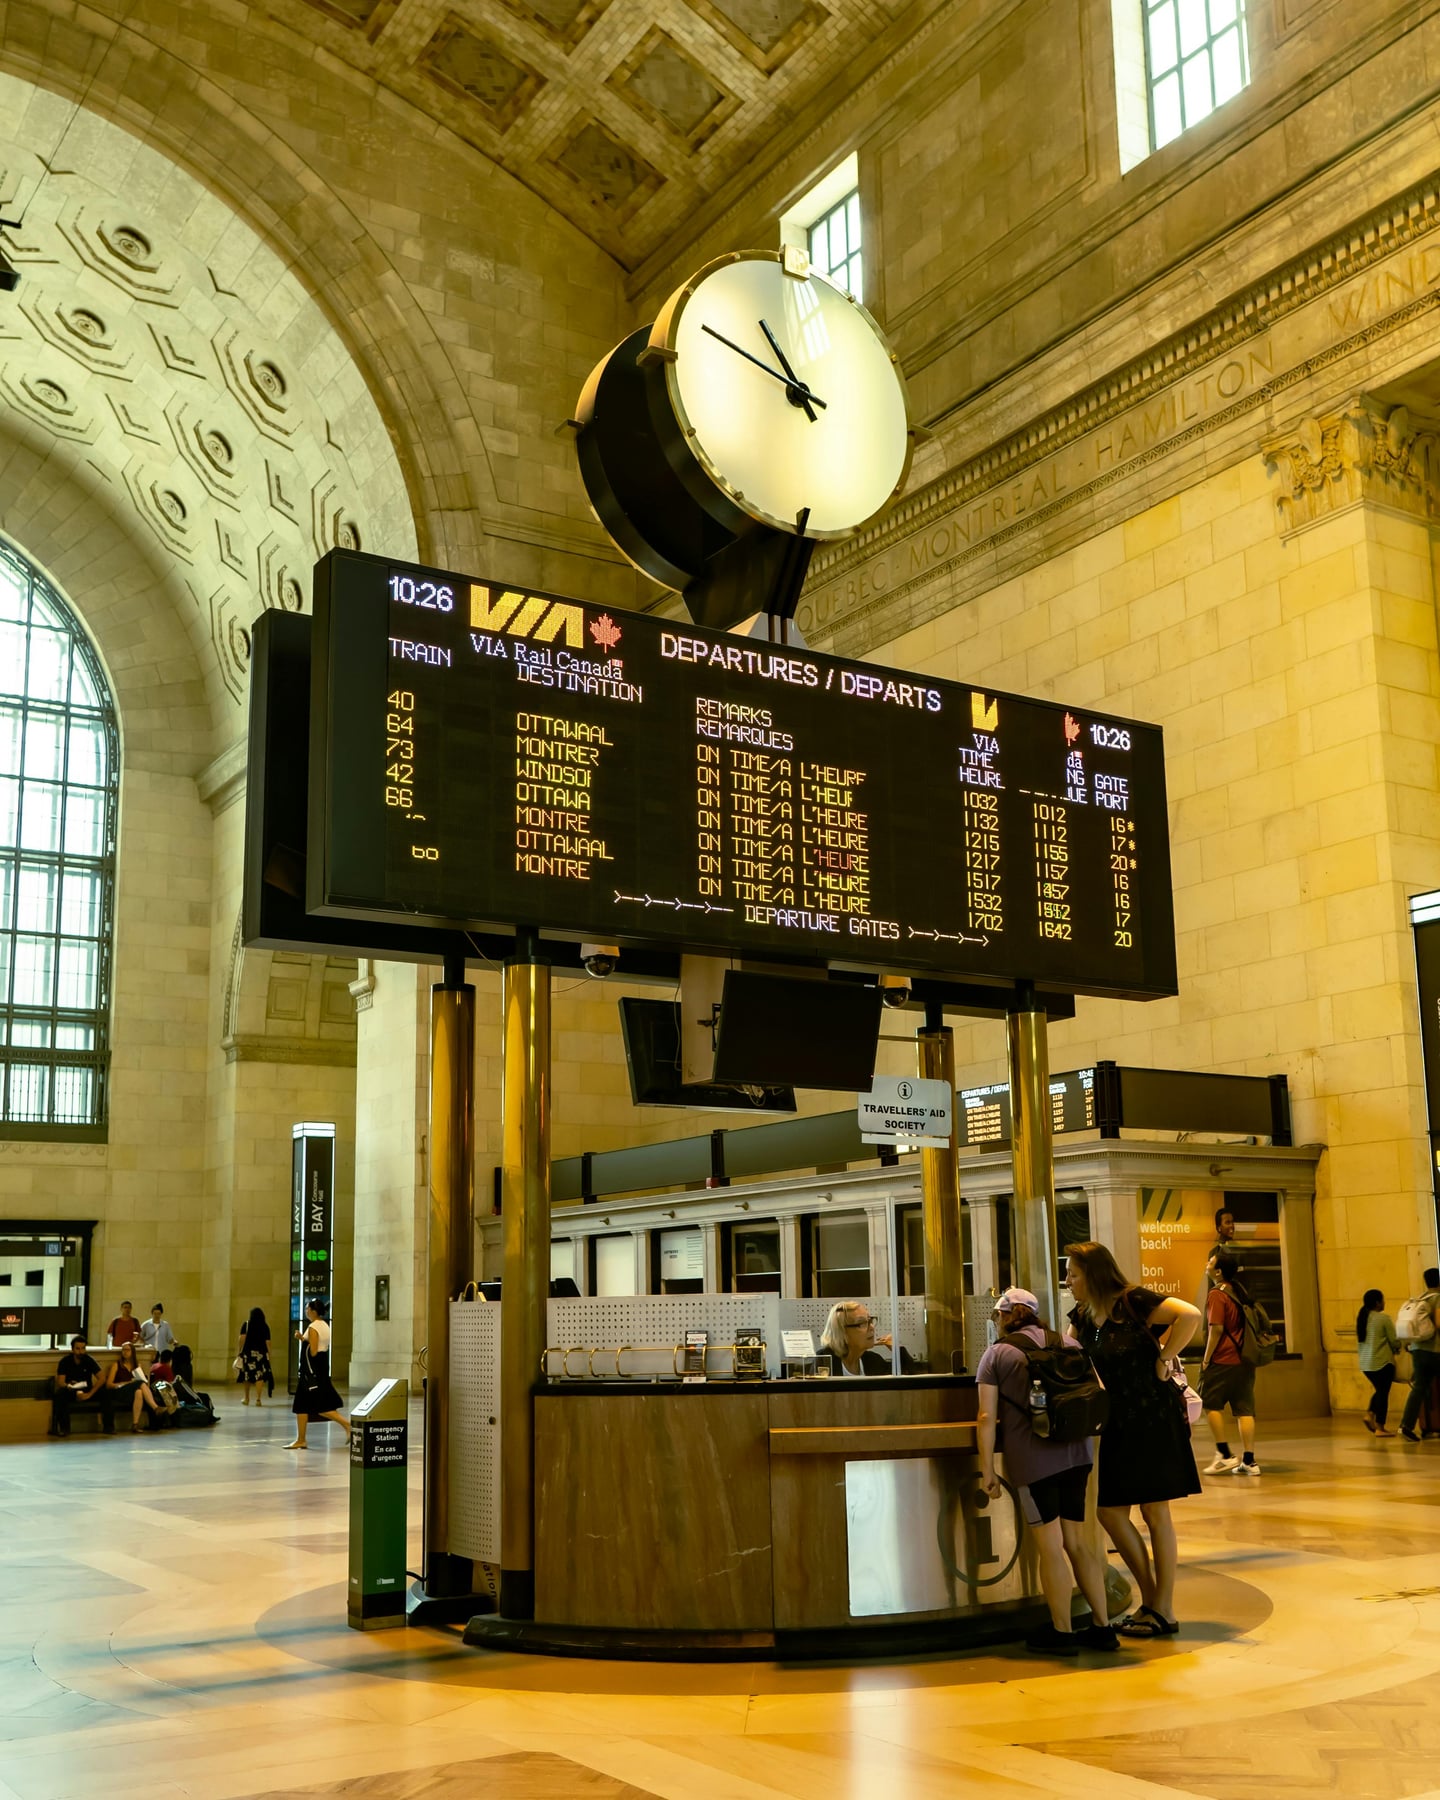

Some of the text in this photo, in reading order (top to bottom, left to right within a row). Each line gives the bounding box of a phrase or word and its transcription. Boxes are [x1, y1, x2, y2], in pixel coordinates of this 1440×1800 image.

[909, 463, 1067, 573] MONTREAL
[1096, 341, 1275, 470] HAMILTON
[389, 576, 453, 612] 10:26
[388, 637, 451, 667] TRAIN
[470, 633, 623, 680] VIA Rail Canada
[661, 632, 818, 687] DEPARTURES
[841, 671, 941, 712] DEPARTS
[517, 663, 642, 703] DESTINATION
[387, 690, 414, 711] 40
[696, 697, 772, 728] REMARKS
[387, 713, 414, 735] 64
[696, 718, 793, 751] REMARQUES
[386, 737, 414, 759] 73
[973, 734, 1000, 754] VIA
[1090, 724, 1131, 751] 10:26
[697, 744, 720, 764] ON
[959, 747, 994, 769] TIME
[386, 763, 414, 784] 42
[697, 766, 720, 786] ON
[959, 766, 1006, 789] HEURE
[1066, 770, 1084, 786] NG
[1094, 774, 1129, 794] GATE
[385, 786, 413, 808] 66
[516, 782, 591, 811] OTTAWA
[964, 790, 998, 811] 1032
[1096, 791, 1129, 811] PORT
[516, 805, 591, 833] MONTRE
[698, 788, 721, 808] ON
[802, 804, 869, 831] L'HEURE
[1034, 803, 1067, 823] 1012
[698, 810, 721, 830] ON
[802, 826, 869, 852] L'HEURE
[964, 810, 1000, 831] 1132
[966, 830, 1000, 851] 1215
[1034, 822, 1068, 842] 1112
[698, 832, 721, 852] ON
[802, 847, 870, 873] L'HEURE
[966, 850, 1001, 870] 1217
[1035, 842, 1069, 862] 1155
[516, 853, 591, 880] MONTRE
[698, 855, 721, 874] ON
[803, 868, 870, 894] L'HEURE
[1036, 861, 1069, 880] 1157
[967, 871, 1001, 890] 1517
[1113, 873, 1129, 890] 16
[699, 877, 722, 897] ON
[804, 889, 871, 915] L'HEURE
[968, 891, 1003, 911] 1532
[1115, 892, 1130, 909] 16
[744, 904, 900, 940] DEPARTURE GATES
[969, 911, 1004, 931] 1702
[1116, 911, 1131, 928] 17
[1039, 921, 1073, 941] 1642
[1114, 930, 1133, 947] 20
[864, 1104, 946, 1118] TRAVELLERS' AID
[885, 1120, 926, 1131] SOCIETY
[311, 1203, 324, 1233] BAY
[1140, 1220, 1191, 1234] welcome
[1140, 1236, 1172, 1250] back!
[1141, 1263, 1164, 1277] bon
[369, 1426, 405, 1434] Emergency
[375, 1434, 400, 1442] Station
[371, 1454, 404, 1463] d'urgence
[374, 1445, 385, 1453] En
[481, 1561, 498, 1599] ation
